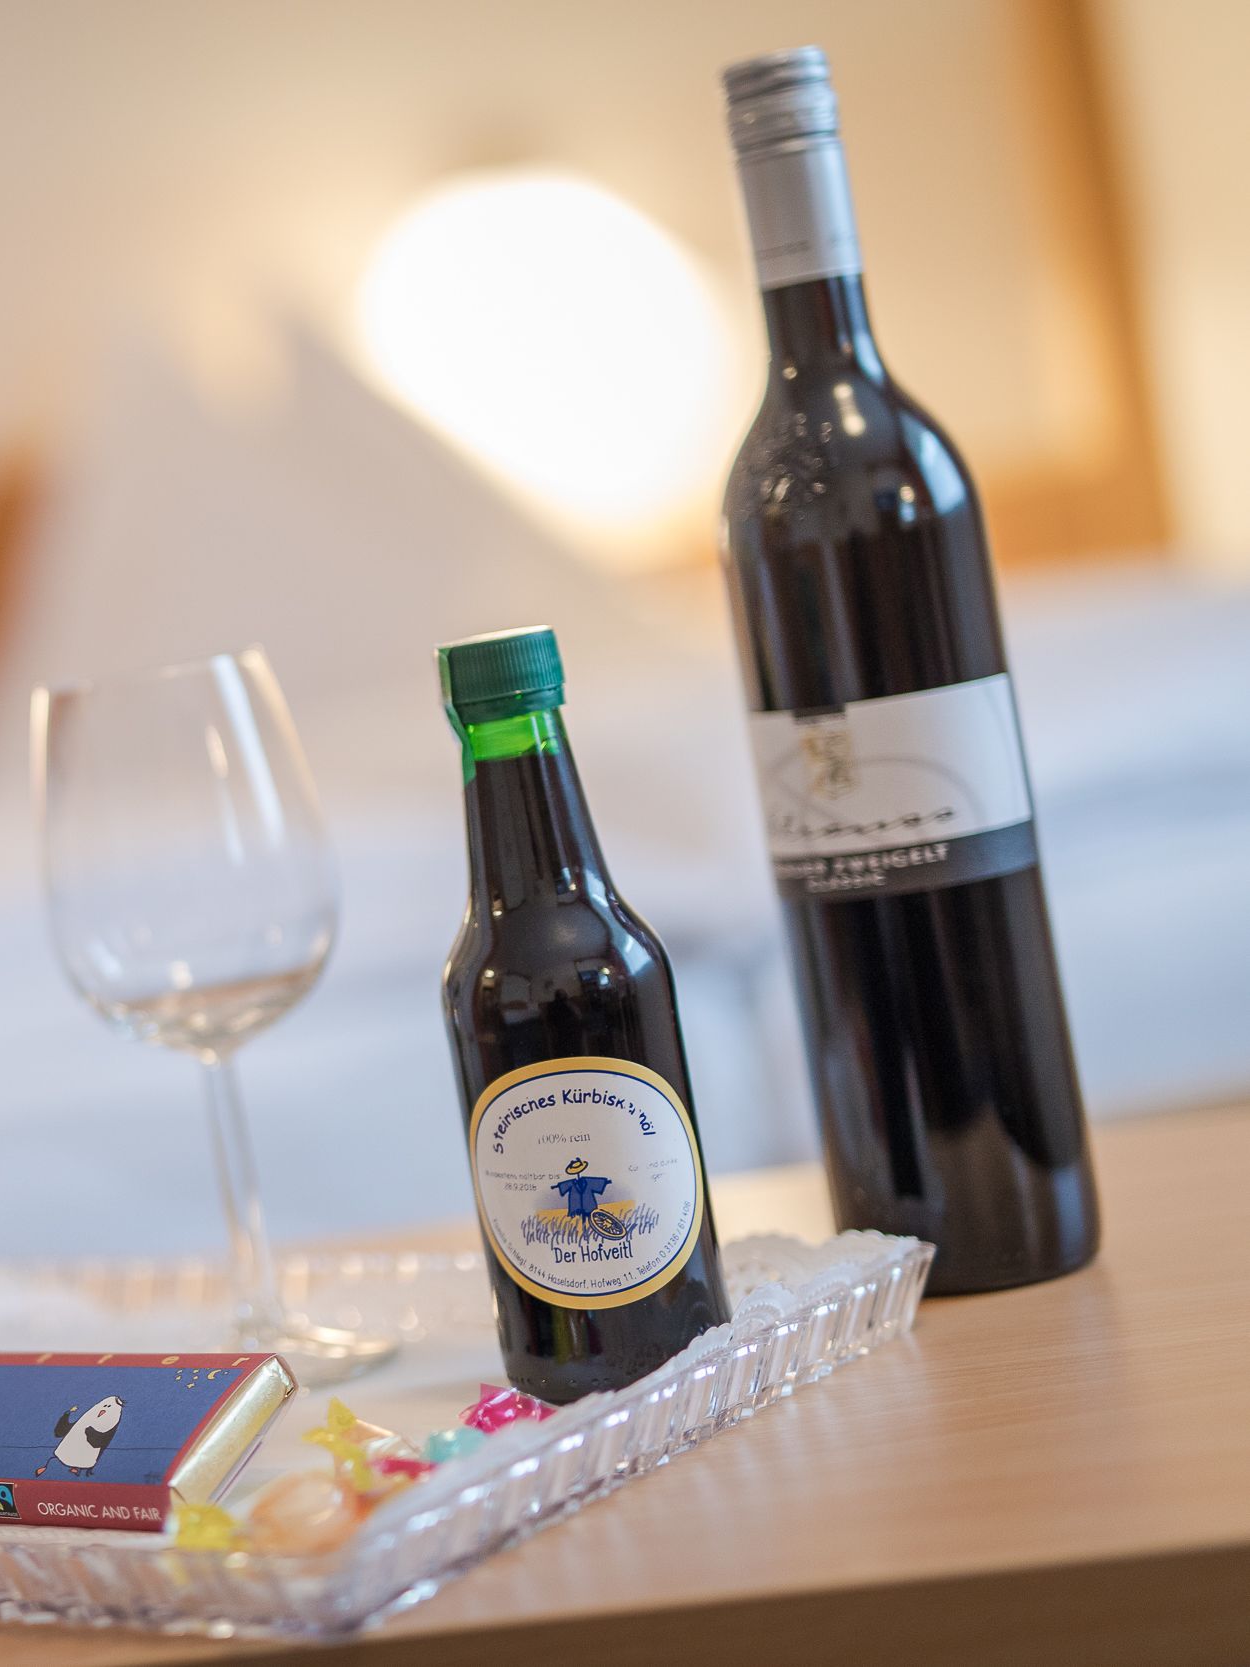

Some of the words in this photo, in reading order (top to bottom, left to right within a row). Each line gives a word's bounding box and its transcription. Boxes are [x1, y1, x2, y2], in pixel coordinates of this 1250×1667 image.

[569, 1132, 591, 1143] rein
[554, 1246, 576, 1263] Der
[580, 1240, 633, 1262] Hofveitl
[591, 1278, 622, 1288] Hofweg
[636, 1256, 661, 1275] Telefon
[37, 1502, 98, 1519] ORGANIC
[102, 1505, 131, 1520] AND
[133, 1506, 162, 1521] FAIR
